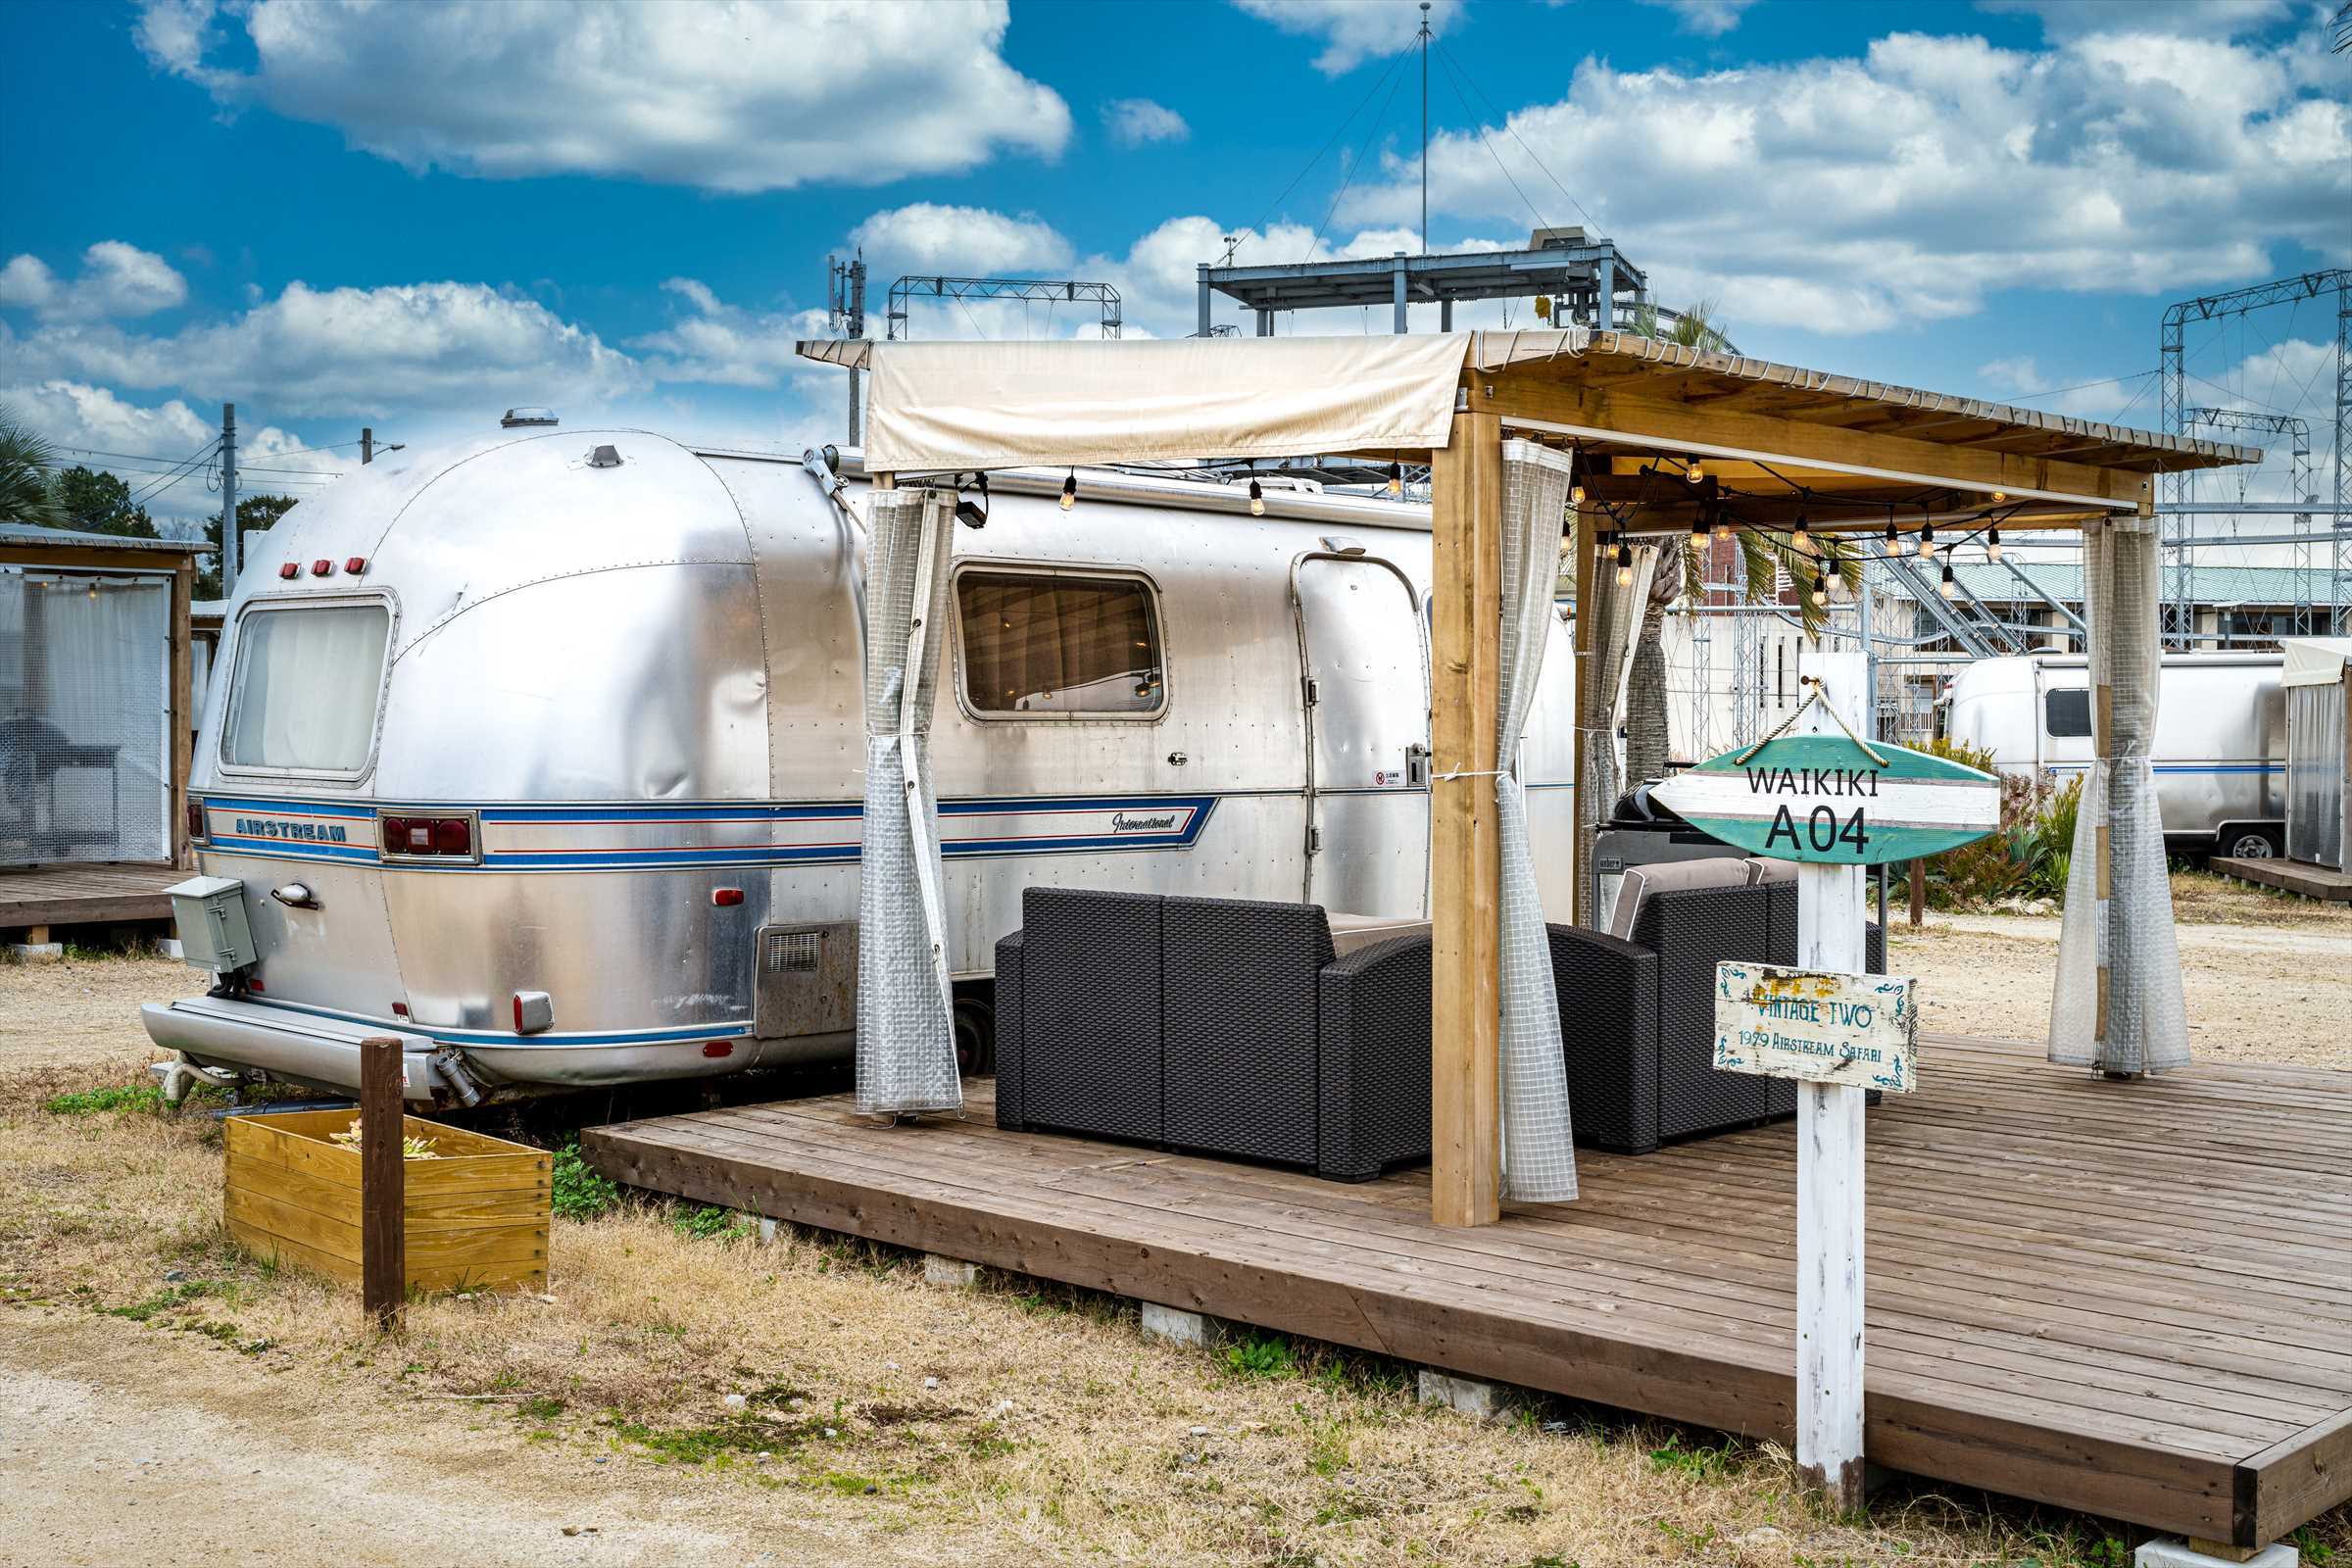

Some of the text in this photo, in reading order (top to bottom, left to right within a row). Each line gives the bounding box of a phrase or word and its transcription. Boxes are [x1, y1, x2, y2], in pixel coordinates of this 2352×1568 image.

[1745, 766, 1880, 798] WAIKIKI
[236, 818, 346, 842] AIRSTREAM
[1112, 811, 1175, 833] International
[1764, 804, 1870, 855] A04
[1757, 994, 1873, 1028] VINTAGE TWO
[1740, 1030, 1882, 1063] 1979 AIRSTREAM SAFARI
